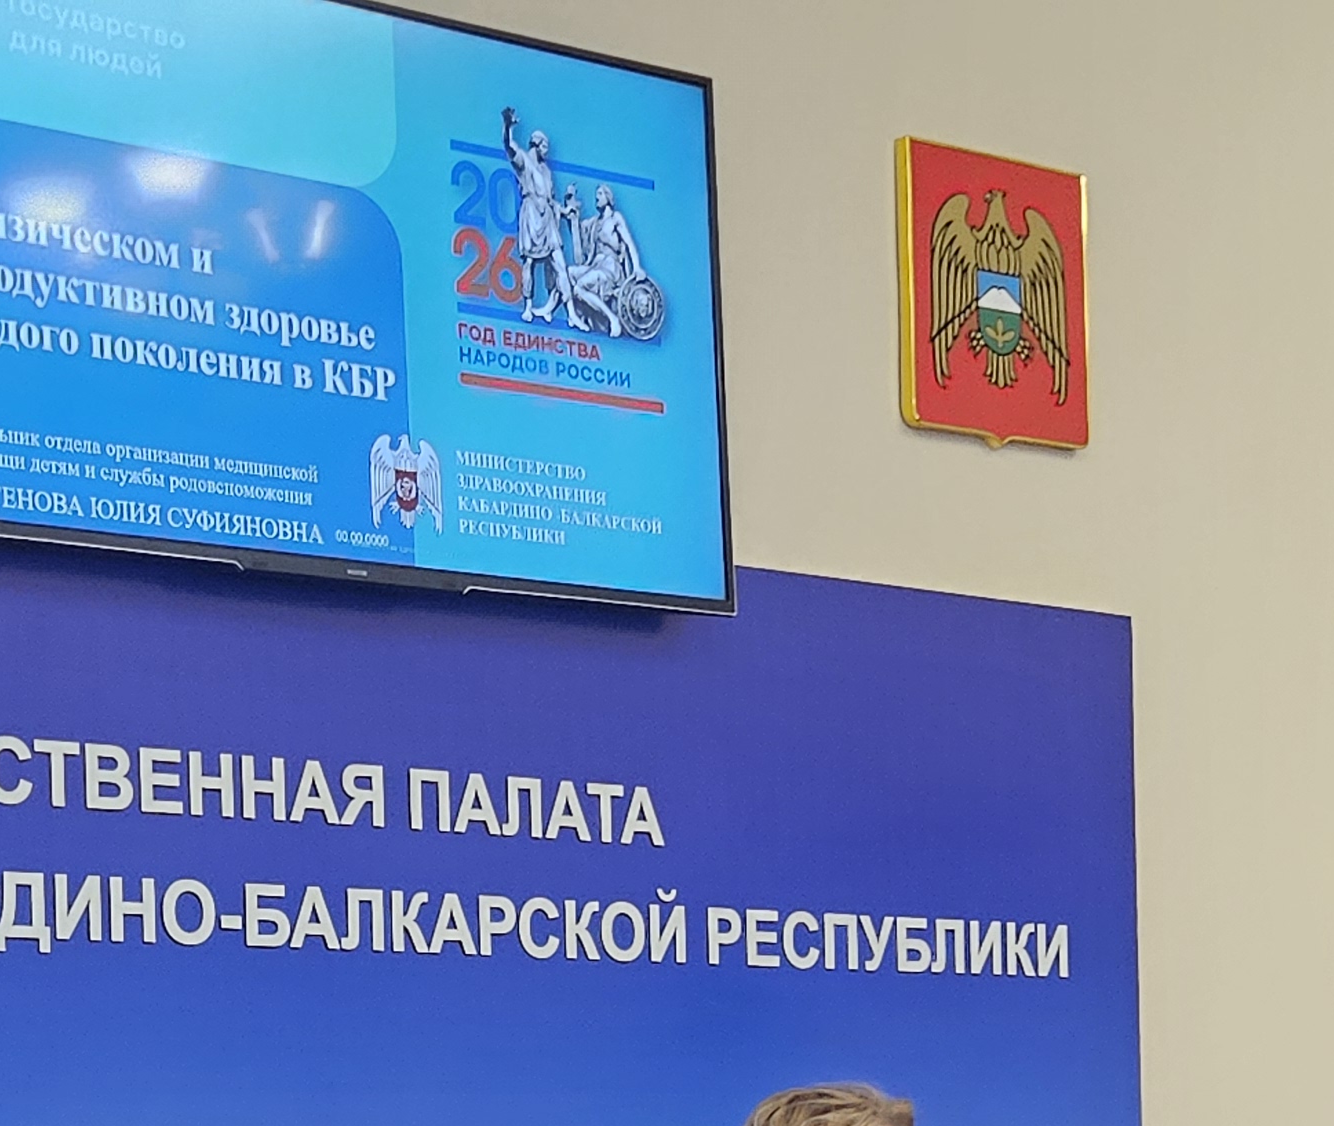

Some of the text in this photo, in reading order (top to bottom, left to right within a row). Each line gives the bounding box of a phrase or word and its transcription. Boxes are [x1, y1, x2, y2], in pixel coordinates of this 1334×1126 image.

[9, 31, 162, 80] для людей
[450, 159, 521, 233] 20
[190, 246, 214, 275] и
[452, 226, 524, 303] 26
[224, 302, 376, 350] здоровье
[457, 322, 601, 361] ГОД ЕДИНСТВА
[90, 333, 282, 386] поколения
[293, 362, 313, 390] в
[322, 358, 396, 401] КБР
[458, 346, 631, 389] НАРОДОВ РОССИИ
[30, 457, 80, 477] детям
[84, 464, 95, 479] и
[100, 466, 165, 488] службы
[44, 435, 101, 455] отдела
[105, 442, 210, 470] организации
[214, 456, 318, 483] медицинской
[455, 450, 586, 481] МИНИСТЕРСТВО
[456, 473, 607, 506] ЗДРАВООХРАНЕНИЯ
[90, 497, 161, 526] ЮЛИЯ
[167, 507, 324, 545] СУФИЯНОВНА
[458, 519, 566, 545] РЕСПУБЛИКИ
[407, 766, 665, 847] ПАЛАТА
[706, 905, 1070, 979] РЕСПУБЛИКИ
